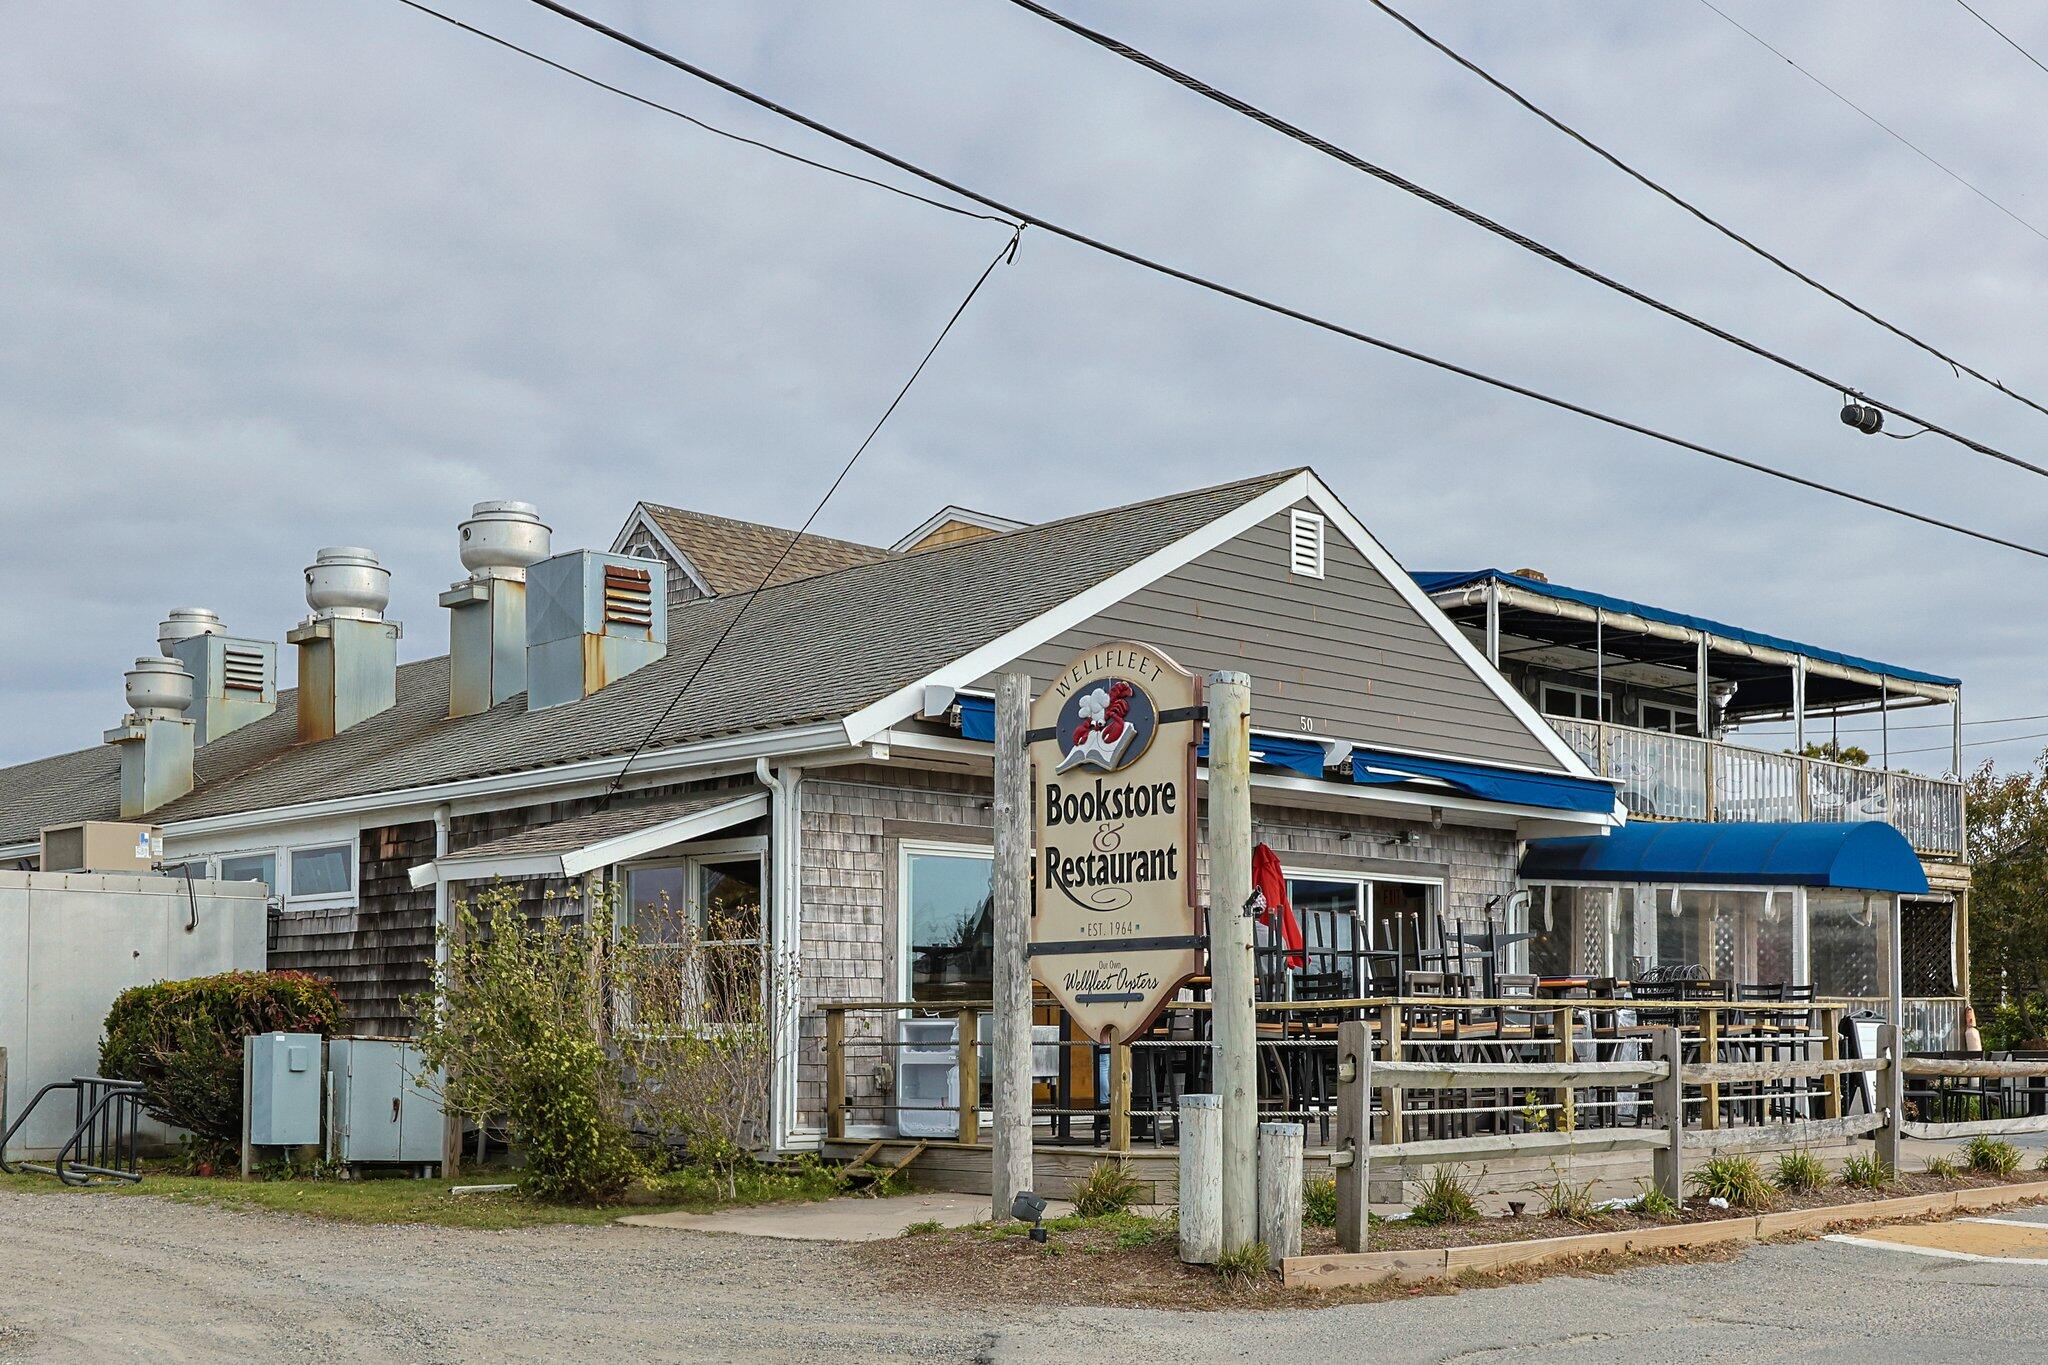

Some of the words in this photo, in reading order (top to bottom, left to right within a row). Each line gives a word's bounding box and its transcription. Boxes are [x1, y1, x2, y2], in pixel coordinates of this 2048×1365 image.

[1056, 650, 1163, 698] WELLFLEET
[1300, 716, 1313, 732] 50
[1046, 778, 1176, 826] Bookstore
[1093, 822, 1124, 853] &
[1045, 843, 1177, 911] Restaurant
[1383, 887, 1402, 905] EXIT
[1088, 922, 1106, 937] EST.
[1110, 921, 1132, 936] 1964
[1098, 960, 1109, 970] Our
[1109, 960, 1121, 970] Own
[1063, 969, 1118, 1007] Wellfleet
[1116, 967, 1159, 1008] Oysters
